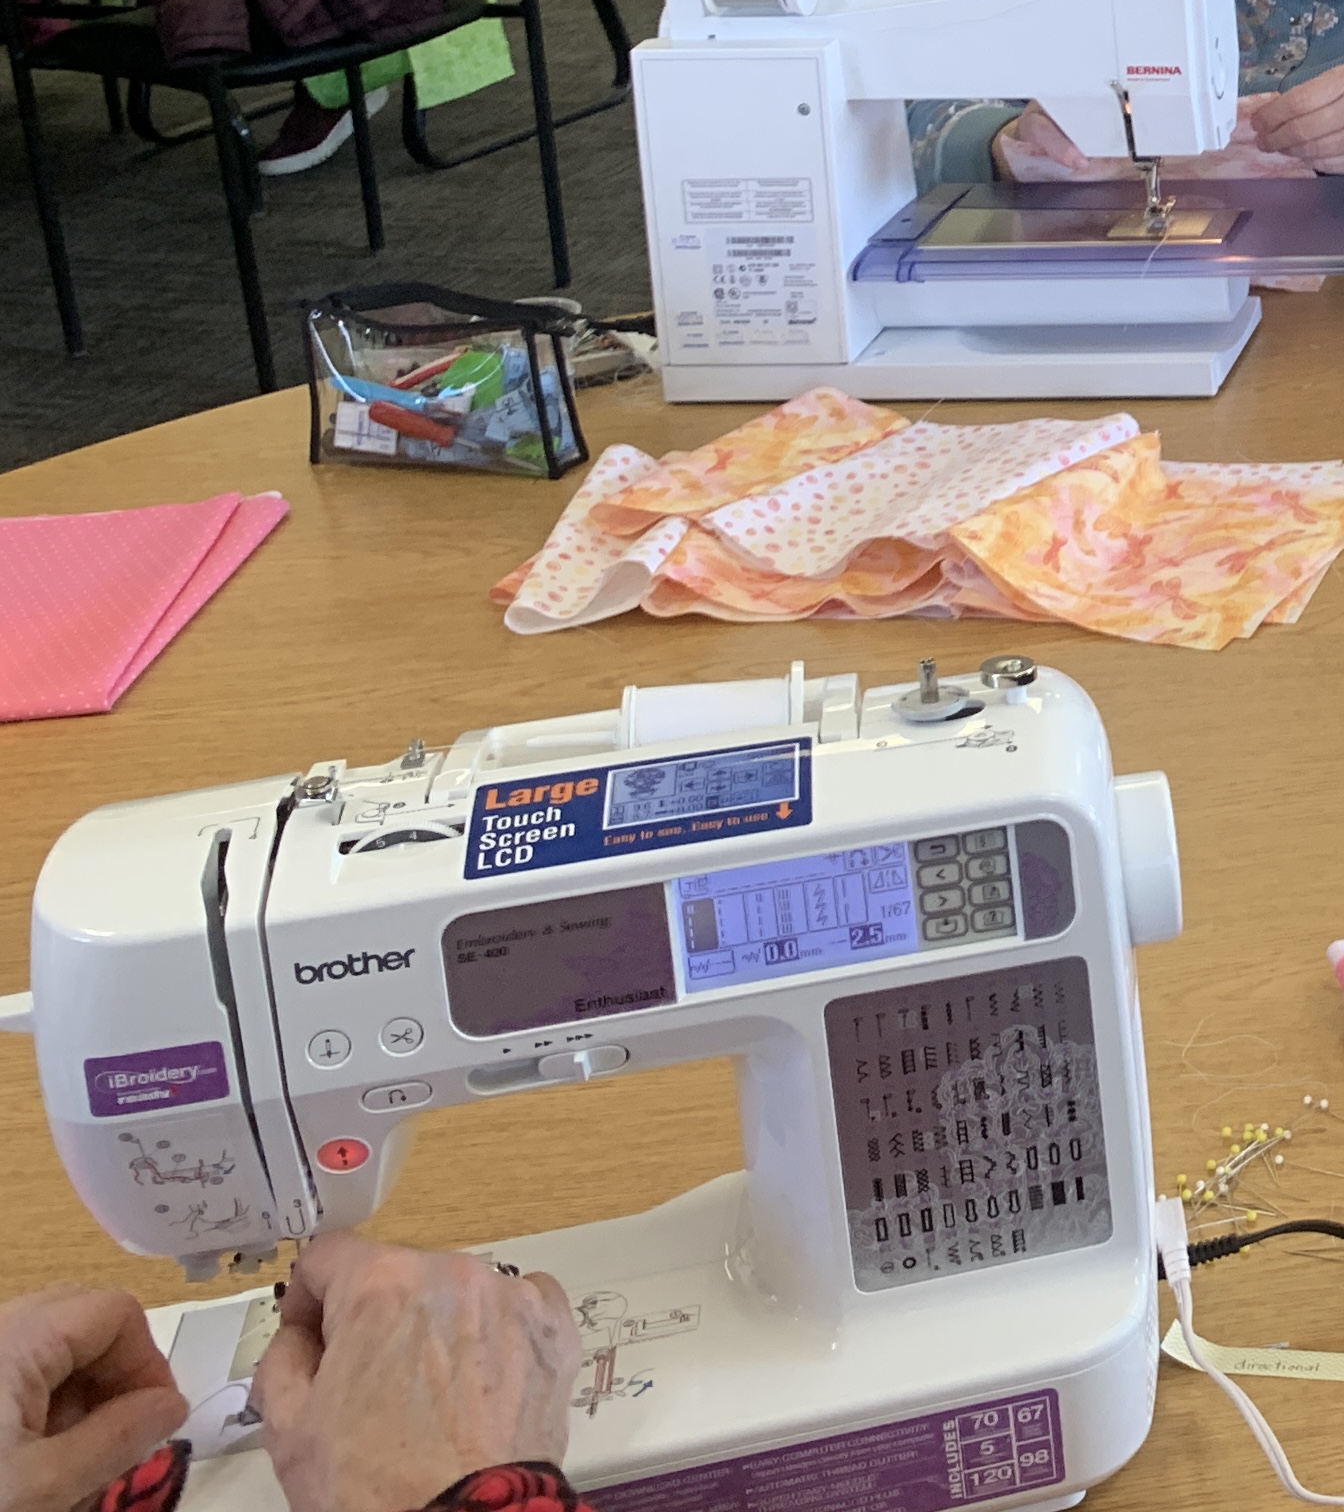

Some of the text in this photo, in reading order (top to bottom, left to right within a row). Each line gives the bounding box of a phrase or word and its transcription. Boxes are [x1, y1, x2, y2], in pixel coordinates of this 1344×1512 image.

[1126, 65, 1182, 75] BERNINA
[484, 776, 601, 811] Large
[482, 806, 562, 833] Touch
[603, 832, 637, 847] Easy
[640, 830, 654, 840] to
[691, 818, 724, 832] Easy
[727, 816, 740, 826] to
[743, 812, 769, 824] use
[478, 821, 576, 851] Screen
[476, 844, 535, 871] LCD
[880, 900, 912, 920] 1/67
[456, 928, 537, 950] Embroidery
[559, 916, 612, 934] Sewing
[764, 939, 798, 965] 0.0
[850, 925, 883, 948] 2.5
[294, 948, 416, 985] brother
[573, 986, 667, 1013] Enthusiast
[108, 1065, 200, 1089] iBroidery
[293, 1199, 302, 1209] 3
[1233, 1359, 1321, 1372] directional
[970, 1410, 999, 1430] 70
[1017, 1404, 1044, 1423] 67
[943, 1419, 963, 1500] INCLUDES
[980, 1440, 996, 1455] 5
[1019, 1449, 1050, 1467] 98
[969, 1466, 1013, 1486] 120
